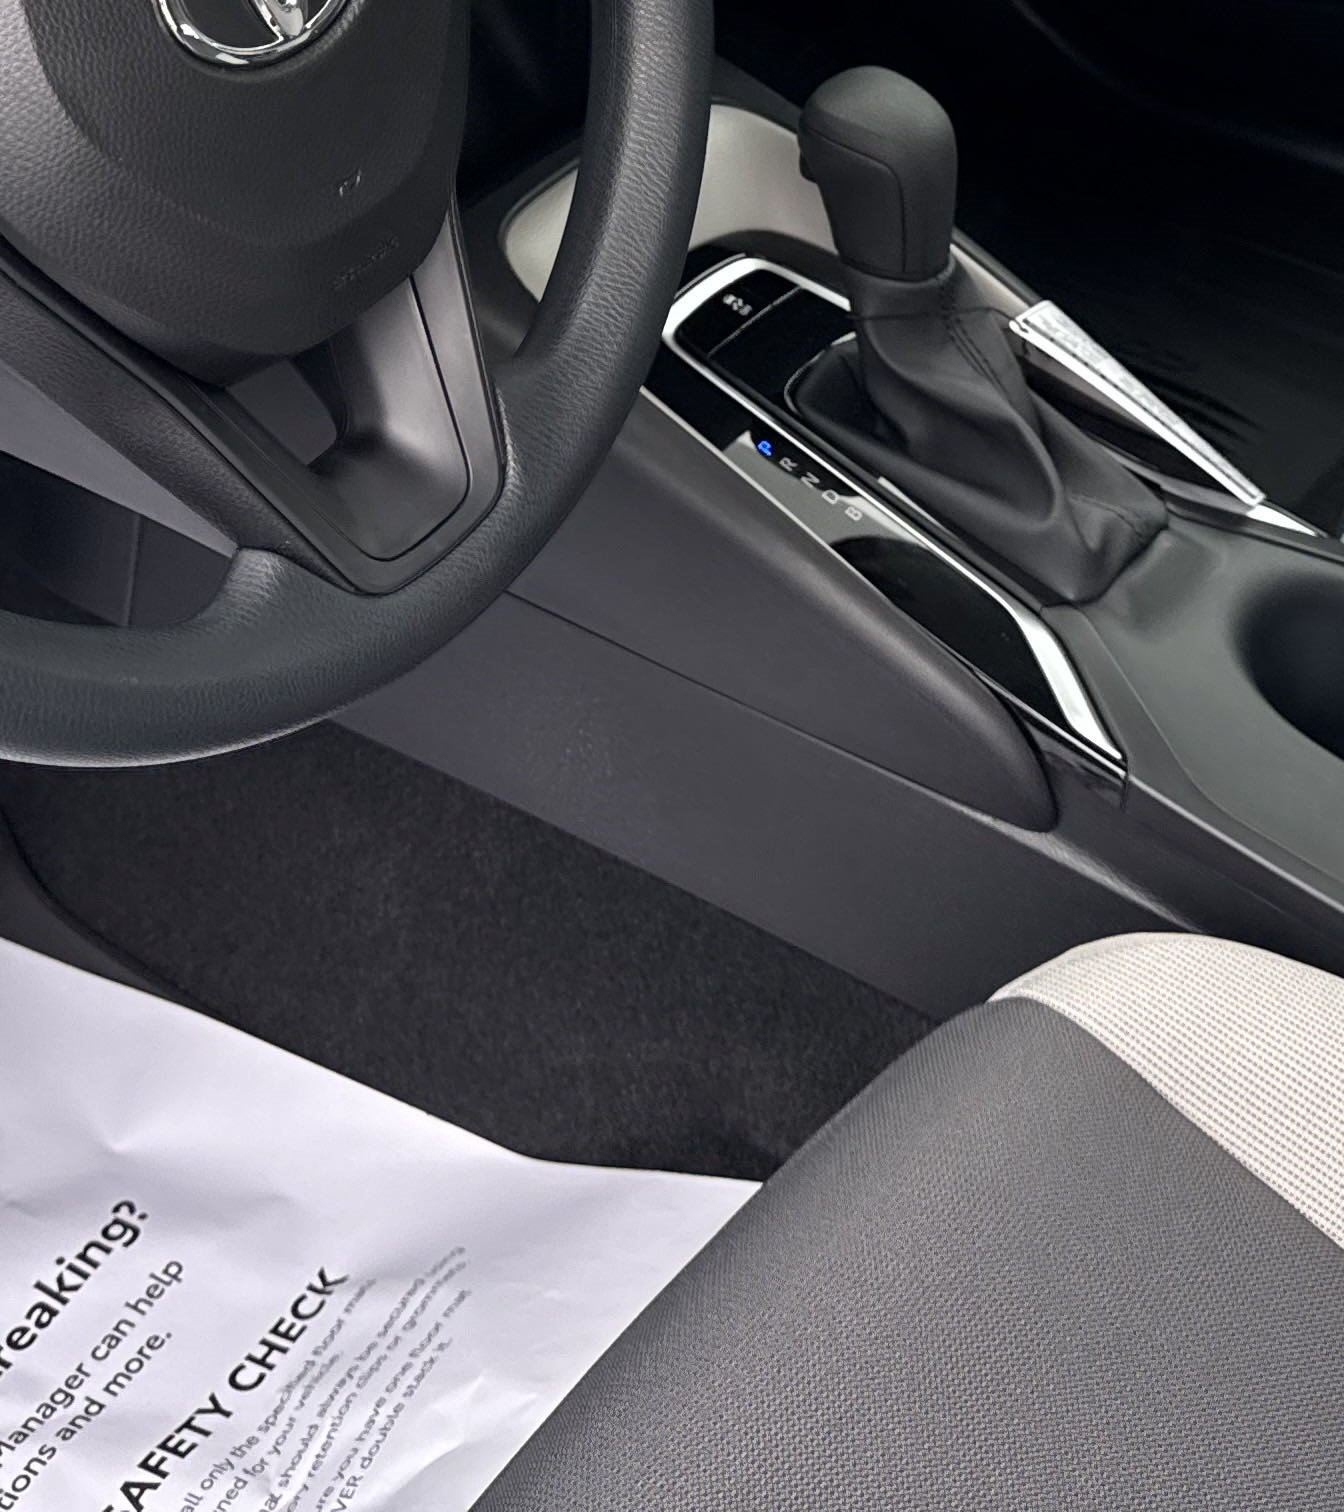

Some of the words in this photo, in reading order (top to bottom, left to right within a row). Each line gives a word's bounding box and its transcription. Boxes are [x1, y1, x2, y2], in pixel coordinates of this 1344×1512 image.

[779, 456, 799, 472] R
[801, 471, 820, 489] N
[821, 489, 840, 505] D
[90, 1318, 136, 1362] can
[125, 1260, 184, 1317] help
[228, 1266, 349, 1392] CHECK
[56, 1396, 106, 1441] and
[102, 1332, 172, 1398] more.
[200, 1458, 235, 1491] only
[230, 1435, 260, 1458] the
[242, 1458, 270, 1477] for
[267, 1416, 296, 1456] your
[278, 1423, 319, 1488] should
[307, 1391, 358, 1478] retention
[332, 1447, 359, 1482] you
[355, 1396, 387, 1442] have
[360, 1402, 405, 1470] double
